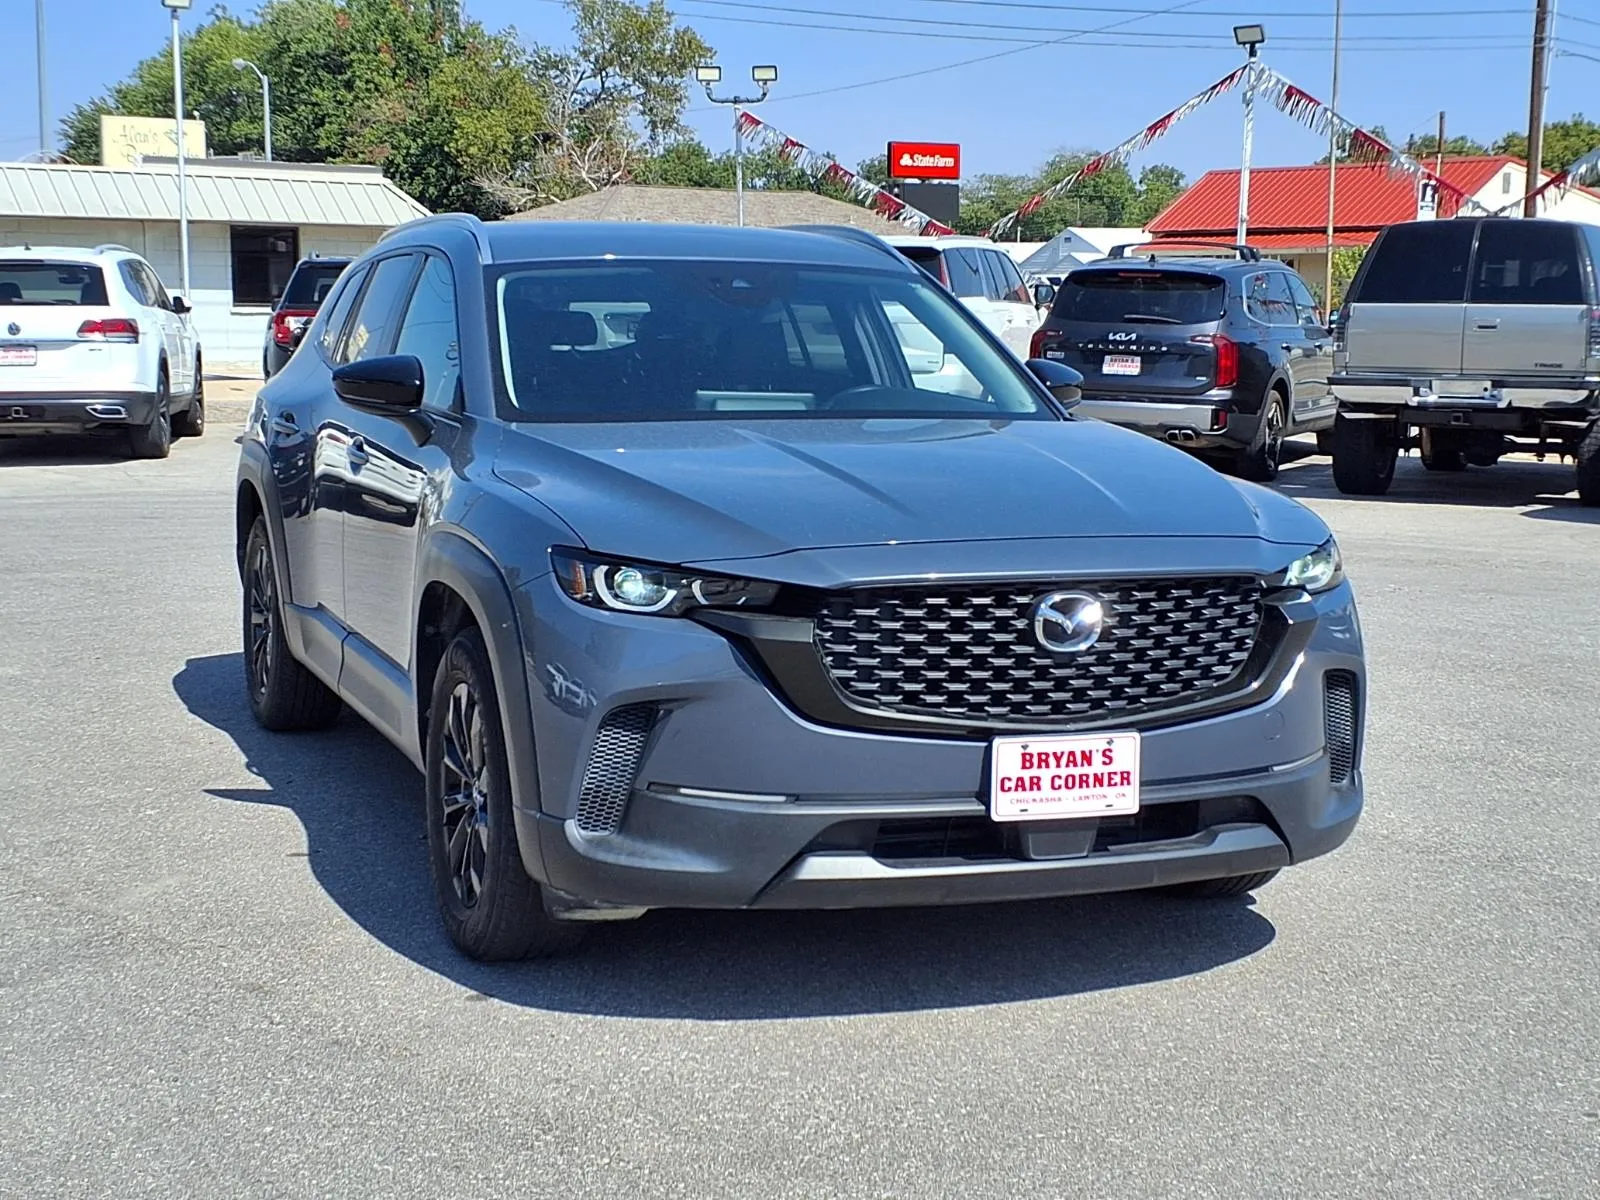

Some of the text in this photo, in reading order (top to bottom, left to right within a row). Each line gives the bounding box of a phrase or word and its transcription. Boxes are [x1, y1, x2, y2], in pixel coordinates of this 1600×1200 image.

[1078, 343, 1168, 351] TELLURIDE
[1020, 748, 1113, 770] BRYAN'S
[1000, 771, 1131, 793] CAR CORNER
